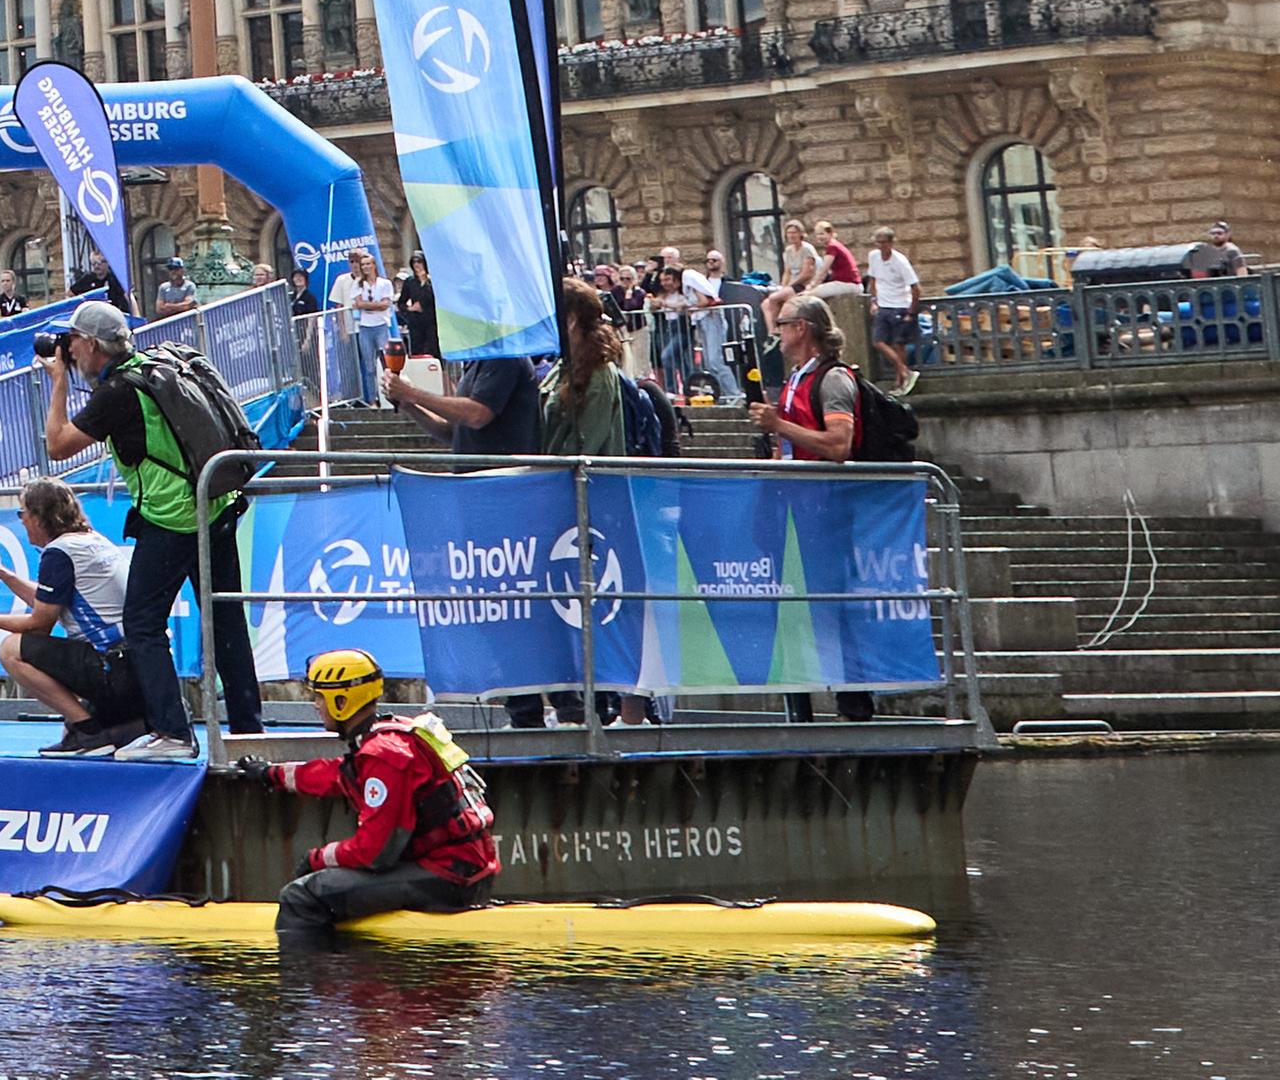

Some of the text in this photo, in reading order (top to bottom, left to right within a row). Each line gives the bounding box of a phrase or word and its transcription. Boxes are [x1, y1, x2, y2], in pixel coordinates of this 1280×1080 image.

[104, 100, 188, 122] MBURG
[110, 122, 161, 142] SSER
[644, 826, 743, 859] HEROS
